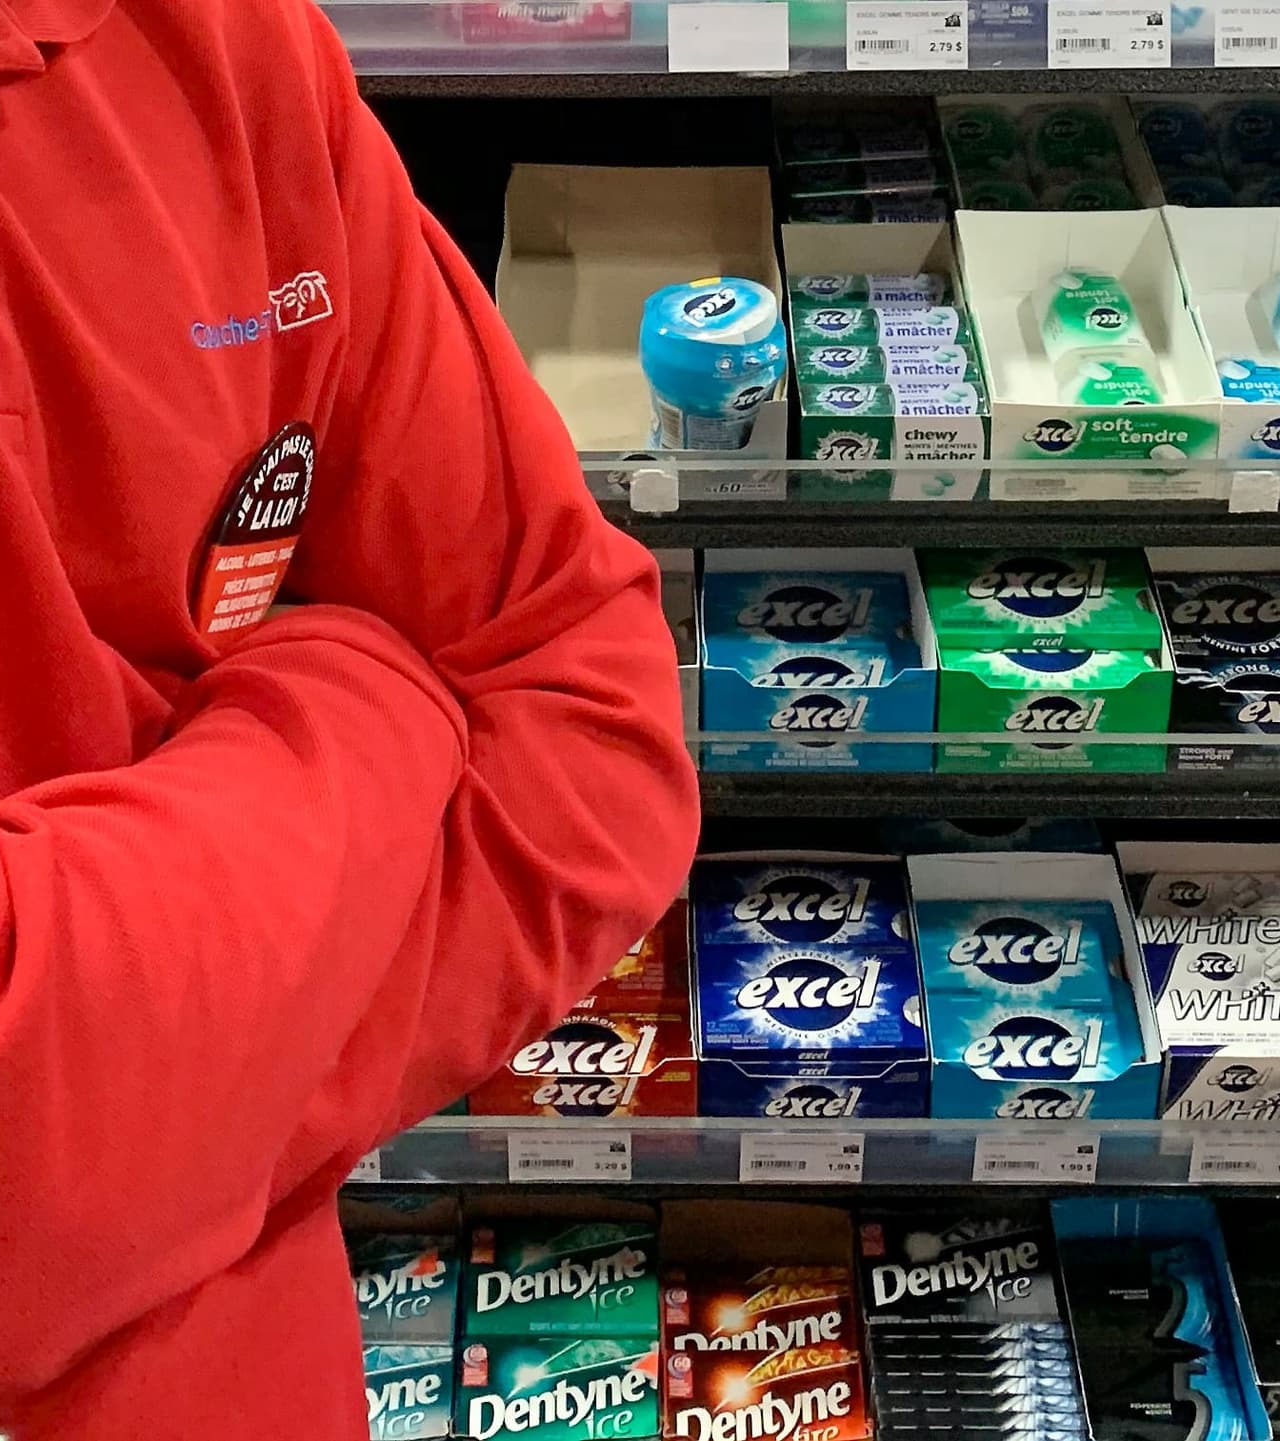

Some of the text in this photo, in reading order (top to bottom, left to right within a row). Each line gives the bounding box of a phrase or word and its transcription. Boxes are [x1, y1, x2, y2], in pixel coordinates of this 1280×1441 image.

[955, 40, 963, 53] $
[1156, 39, 1165, 51] $
[884, 290, 939, 303] mâcher
[885, 325, 953, 337] à mâcher
[891, 363, 961, 375] à mâcher
[912, 403, 972, 415] mâcher
[1091, 416, 1134, 432] soft
[280, 434, 301, 461] PAS
[904, 429, 958, 442] chewy
[1023, 420, 1088, 446] excel
[1120, 428, 1189, 444] tendre
[273, 471, 300, 492] C'EST
[250, 495, 300, 530] LA LOI
[967, 559, 1107, 600] excel
[736, 587, 873, 629] excel
[1031, 635, 1064, 647] excel
[770, 695, 869, 732] excel
[1004, 696, 1105, 732] excel
[733, 877, 871, 923] excel
[948, 920, 1082, 966] excel
[1186, 953, 1247, 975] excel
[735, 954, 883, 1010] excel
[511, 1025, 658, 1076] excel
[963, 1018, 1105, 1071] excel
[764, 1085, 863, 1119] excel
[995, 1087, 1094, 1119] excel
[476, 1244, 647, 1314] Dentyne
[872, 1235, 1040, 1307] Dentyne
[468, 1366, 659, 1440] Dentyne
[674, 1379, 852, 1441] Dentyne
